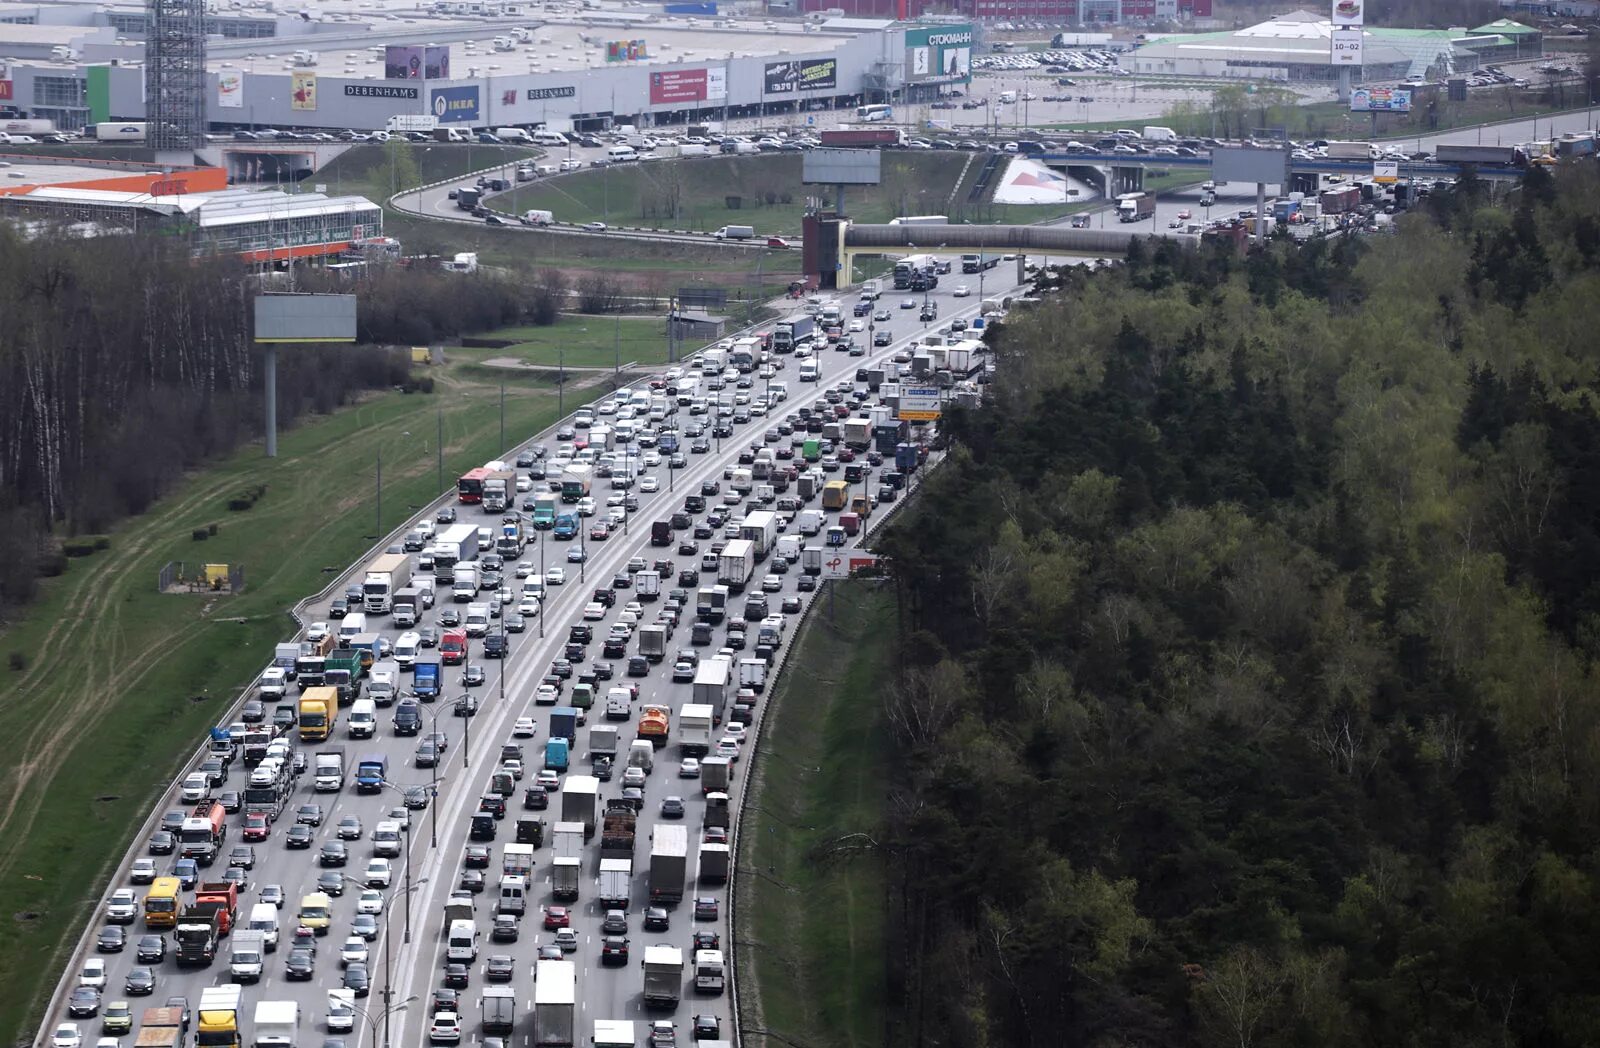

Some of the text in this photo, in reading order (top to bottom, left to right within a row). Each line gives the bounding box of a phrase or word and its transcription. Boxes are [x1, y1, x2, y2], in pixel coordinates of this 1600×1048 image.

[929, 32, 971, 45] СТОКМАНН
[347, 86, 415, 98] DEBENHAMS
[529, 87, 575, 99] DEBENHAMS
[448, 98, 475, 110] IKEA
